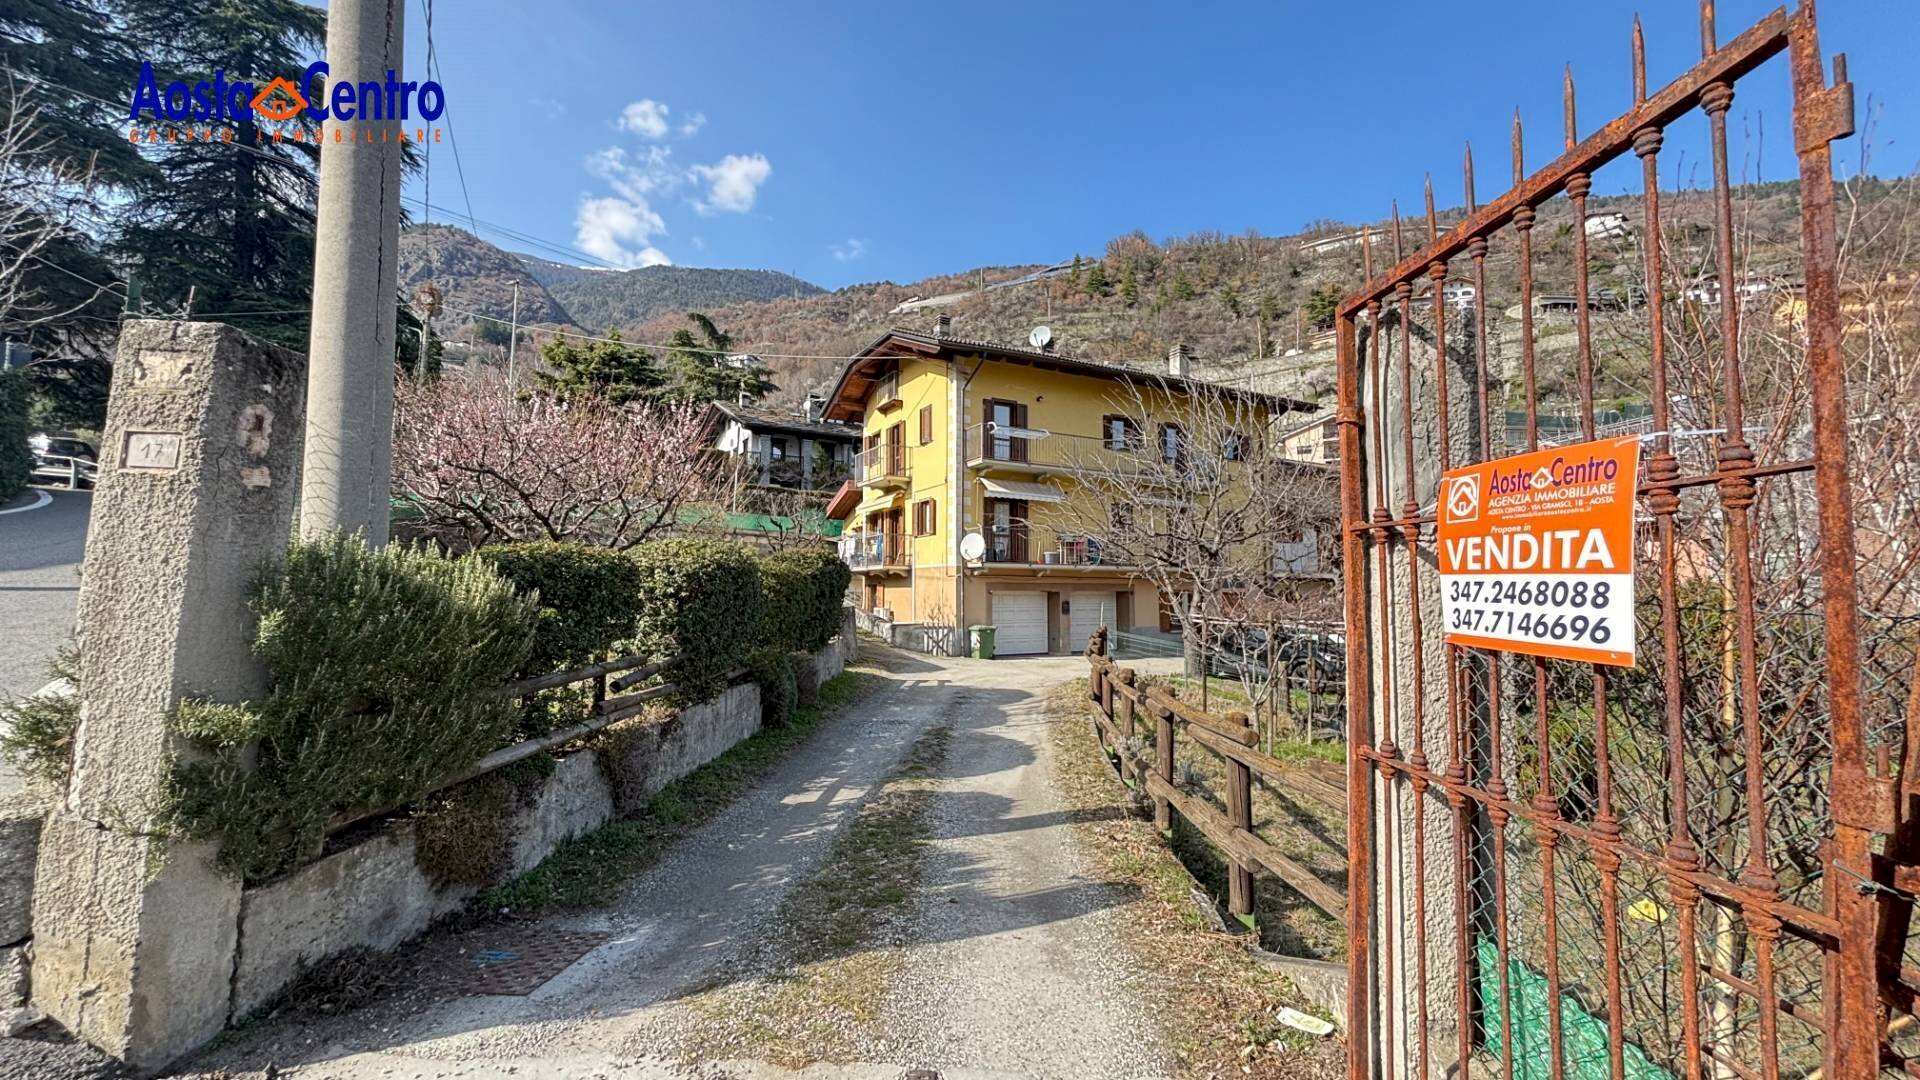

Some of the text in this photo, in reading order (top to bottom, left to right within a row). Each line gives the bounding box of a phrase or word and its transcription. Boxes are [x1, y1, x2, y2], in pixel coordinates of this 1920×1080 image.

[140, 443, 164, 459] 17
[1489, 456, 1618, 496] Aosta Centro
[1488, 483, 1616, 508] AGENZIA IMMOBILIARE
[1589, 496, 1614, 505] AOSTA
[1491, 523, 1531, 534] Propone in
[1445, 528, 1615, 571] VENDITA
[1450, 580, 1611, 609] 347.2468088
[1452, 608, 1611, 644] 347.7146696
